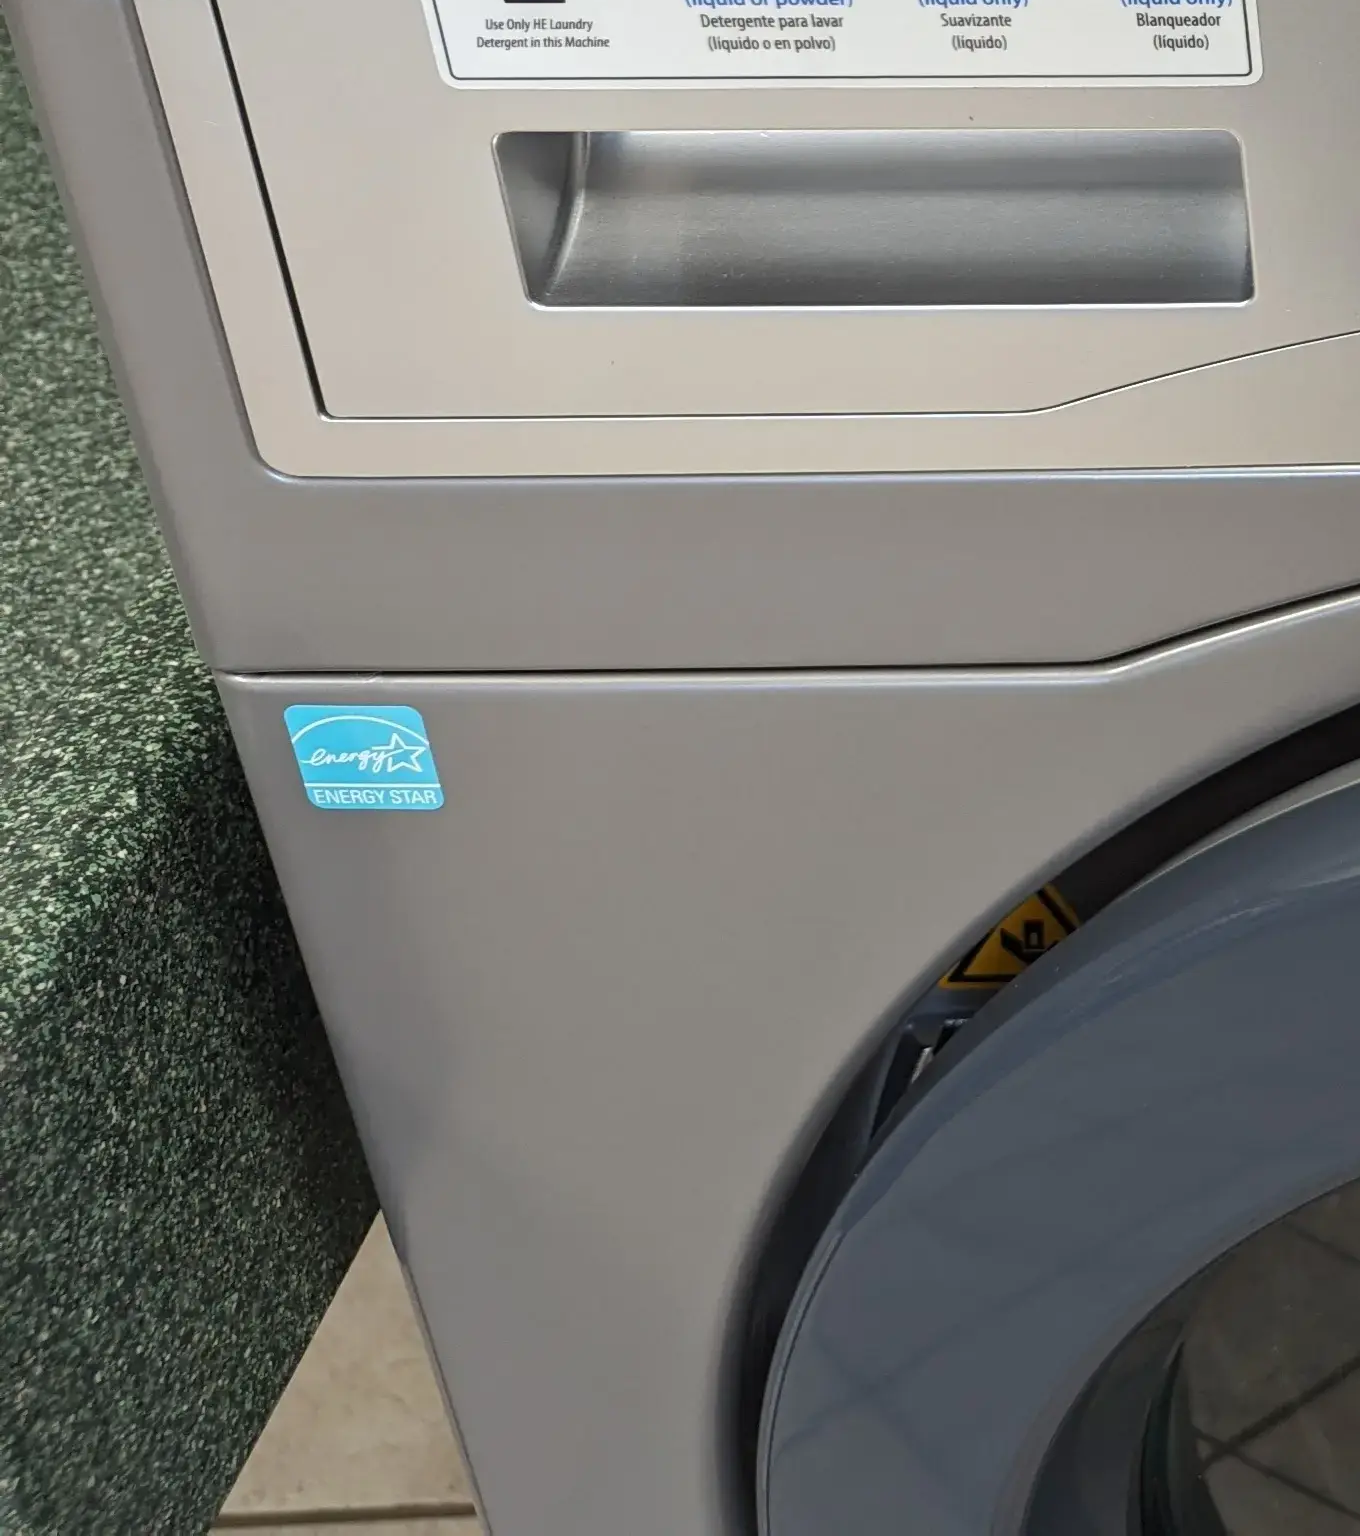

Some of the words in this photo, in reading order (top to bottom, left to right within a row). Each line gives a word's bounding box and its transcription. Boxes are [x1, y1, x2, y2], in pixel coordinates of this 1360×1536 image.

[485, 19, 504, 30] Use
[506, 18, 530, 32] Only
[533, 19, 547, 30] HE
[550, 19, 593, 32] Laundry
[700, 14, 775, 31] Detergente
[778, 16, 808, 31] para
[810, 14, 844, 28] lavar
[940, 13, 1012, 27] Suavizante
[1136, 12, 1222, 30] Blanqueador
[477, 37, 528, 50] Detergent
[530, 37, 541, 48] in
[543, 37, 563, 48] this
[565, 37, 610, 48] Machine
[762, 39, 771, 50] o
[774, 39, 791, 50] en
[794, 36, 836, 53] polvo)
[300, 748, 388, 773] energy
[313, 789, 385, 804] ENERGY
[389, 789, 437, 804] STAR
